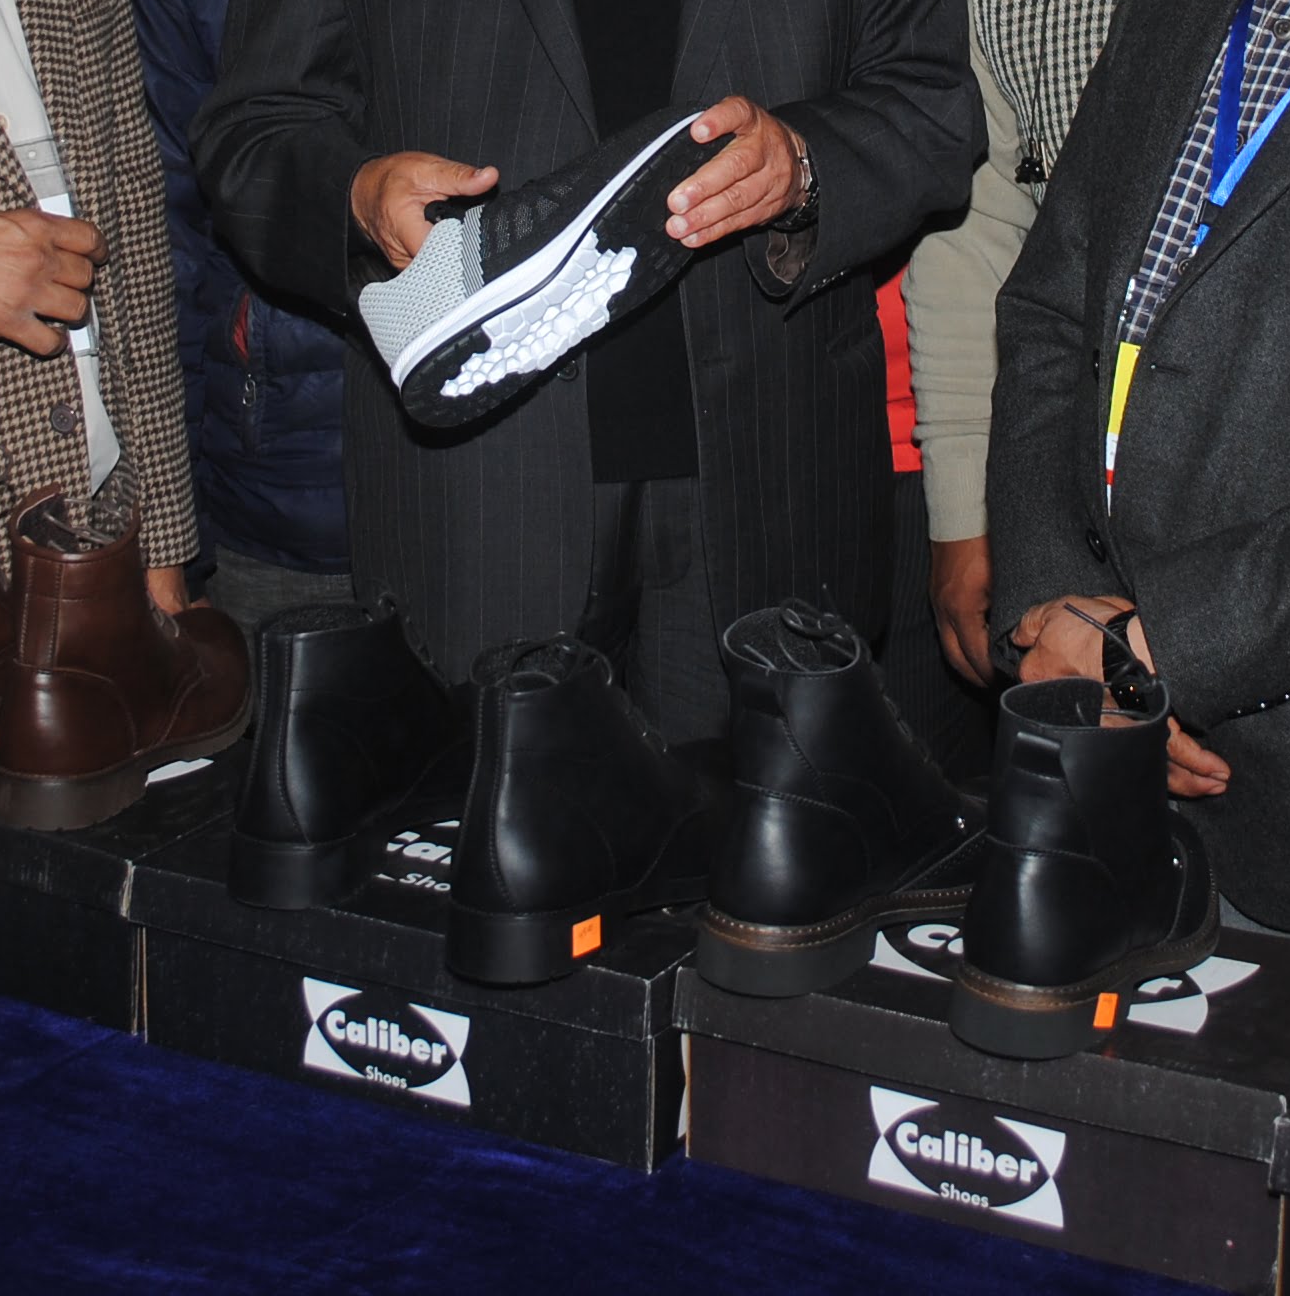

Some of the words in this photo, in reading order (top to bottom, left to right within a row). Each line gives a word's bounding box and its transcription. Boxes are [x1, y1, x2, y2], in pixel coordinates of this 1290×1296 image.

[325, 1008, 448, 1068] Caliber
[365, 1064, 409, 1091] Shoes
[894, 1118, 1040, 1184] Caliber
[939, 1181, 991, 1210] Shoes
